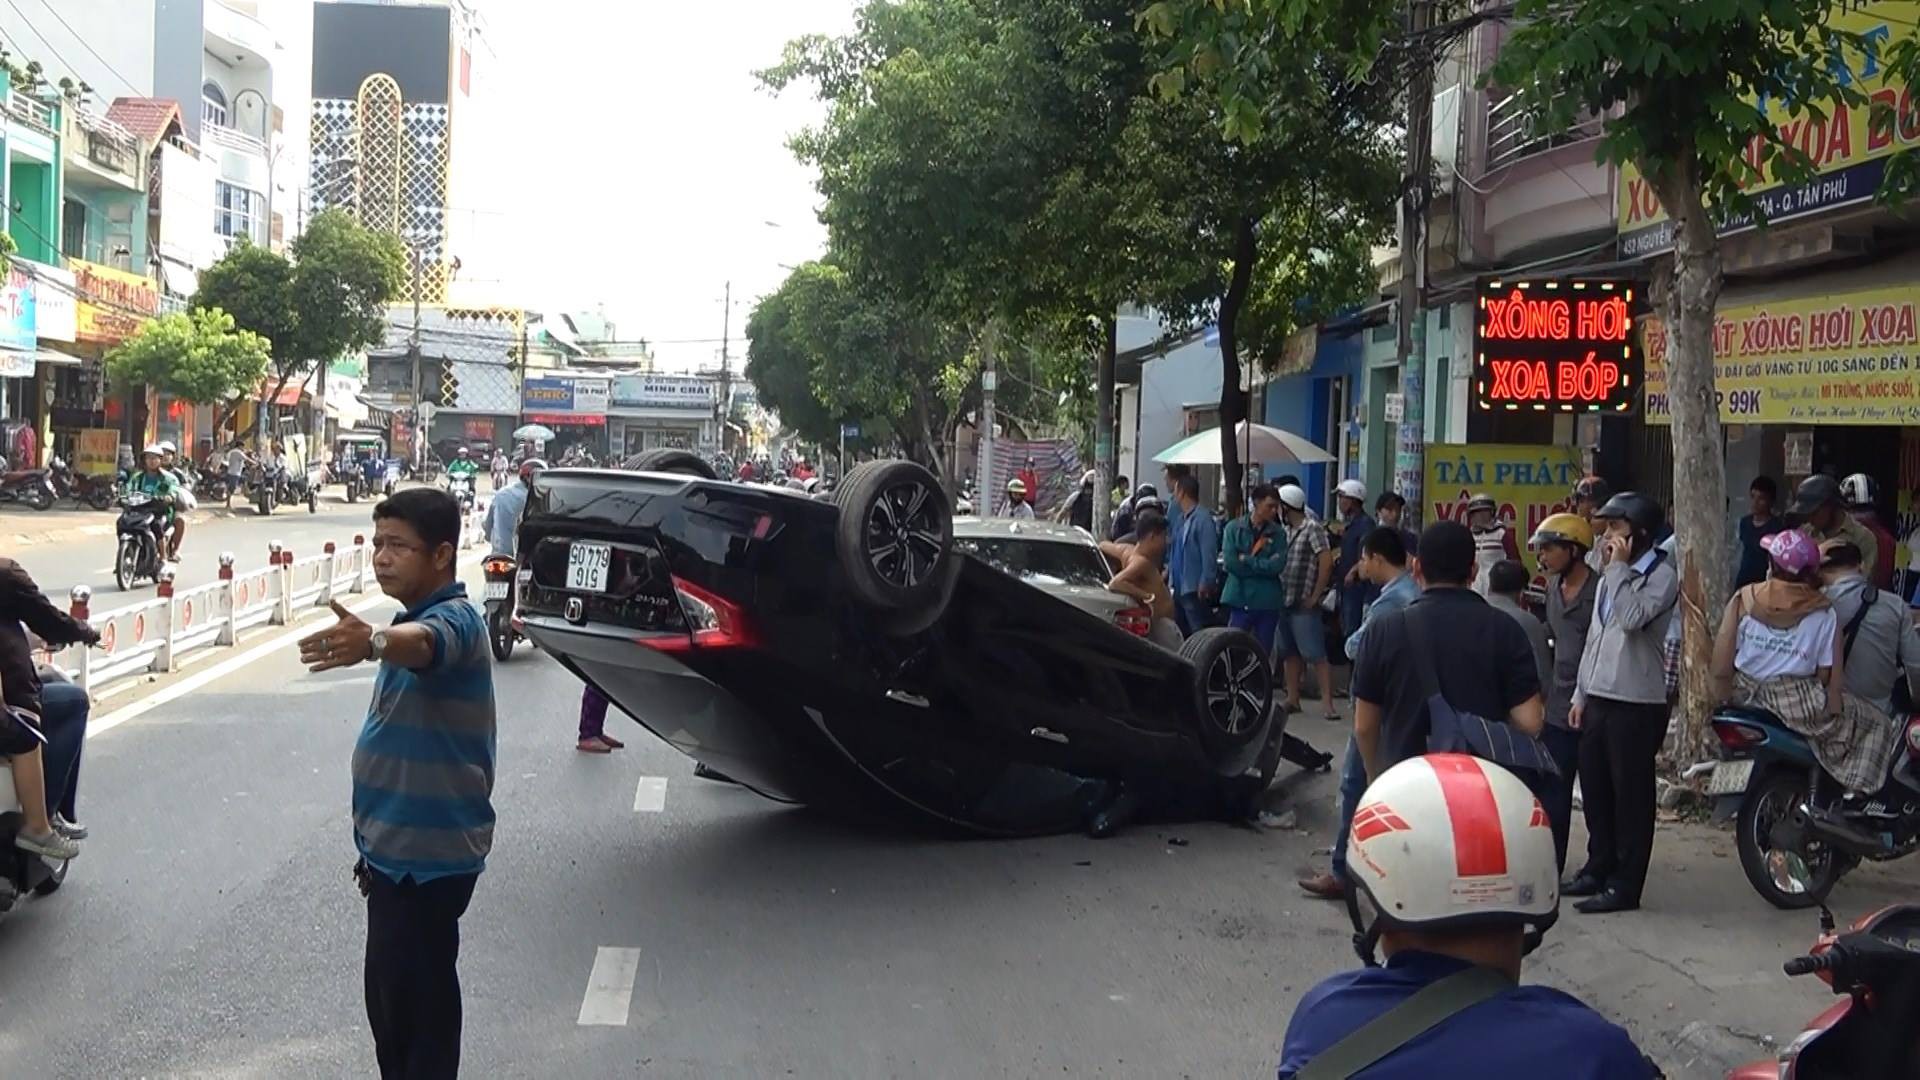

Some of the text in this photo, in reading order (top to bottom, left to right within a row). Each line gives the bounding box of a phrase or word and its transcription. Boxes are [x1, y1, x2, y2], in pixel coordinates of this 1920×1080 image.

[1797, 184, 1820, 208] TÂN
[1823, 173, 1848, 203] PHÚ
[1486, 290, 1627, 340] XÔNG HƠI
[1740, 311, 1801, 355] XÔNG
[1809, 307, 1855, 349] HƠI
[1860, 304, 1917, 348] XOA
[1491, 352, 1619, 400] XOA BÓP
[1817, 359, 1839, 374] 10G
[1729, 390, 1760, 415] 99K
[1434, 457, 1573, 485] TÀI PHÁT
[576, 567, 599, 588] 51G
